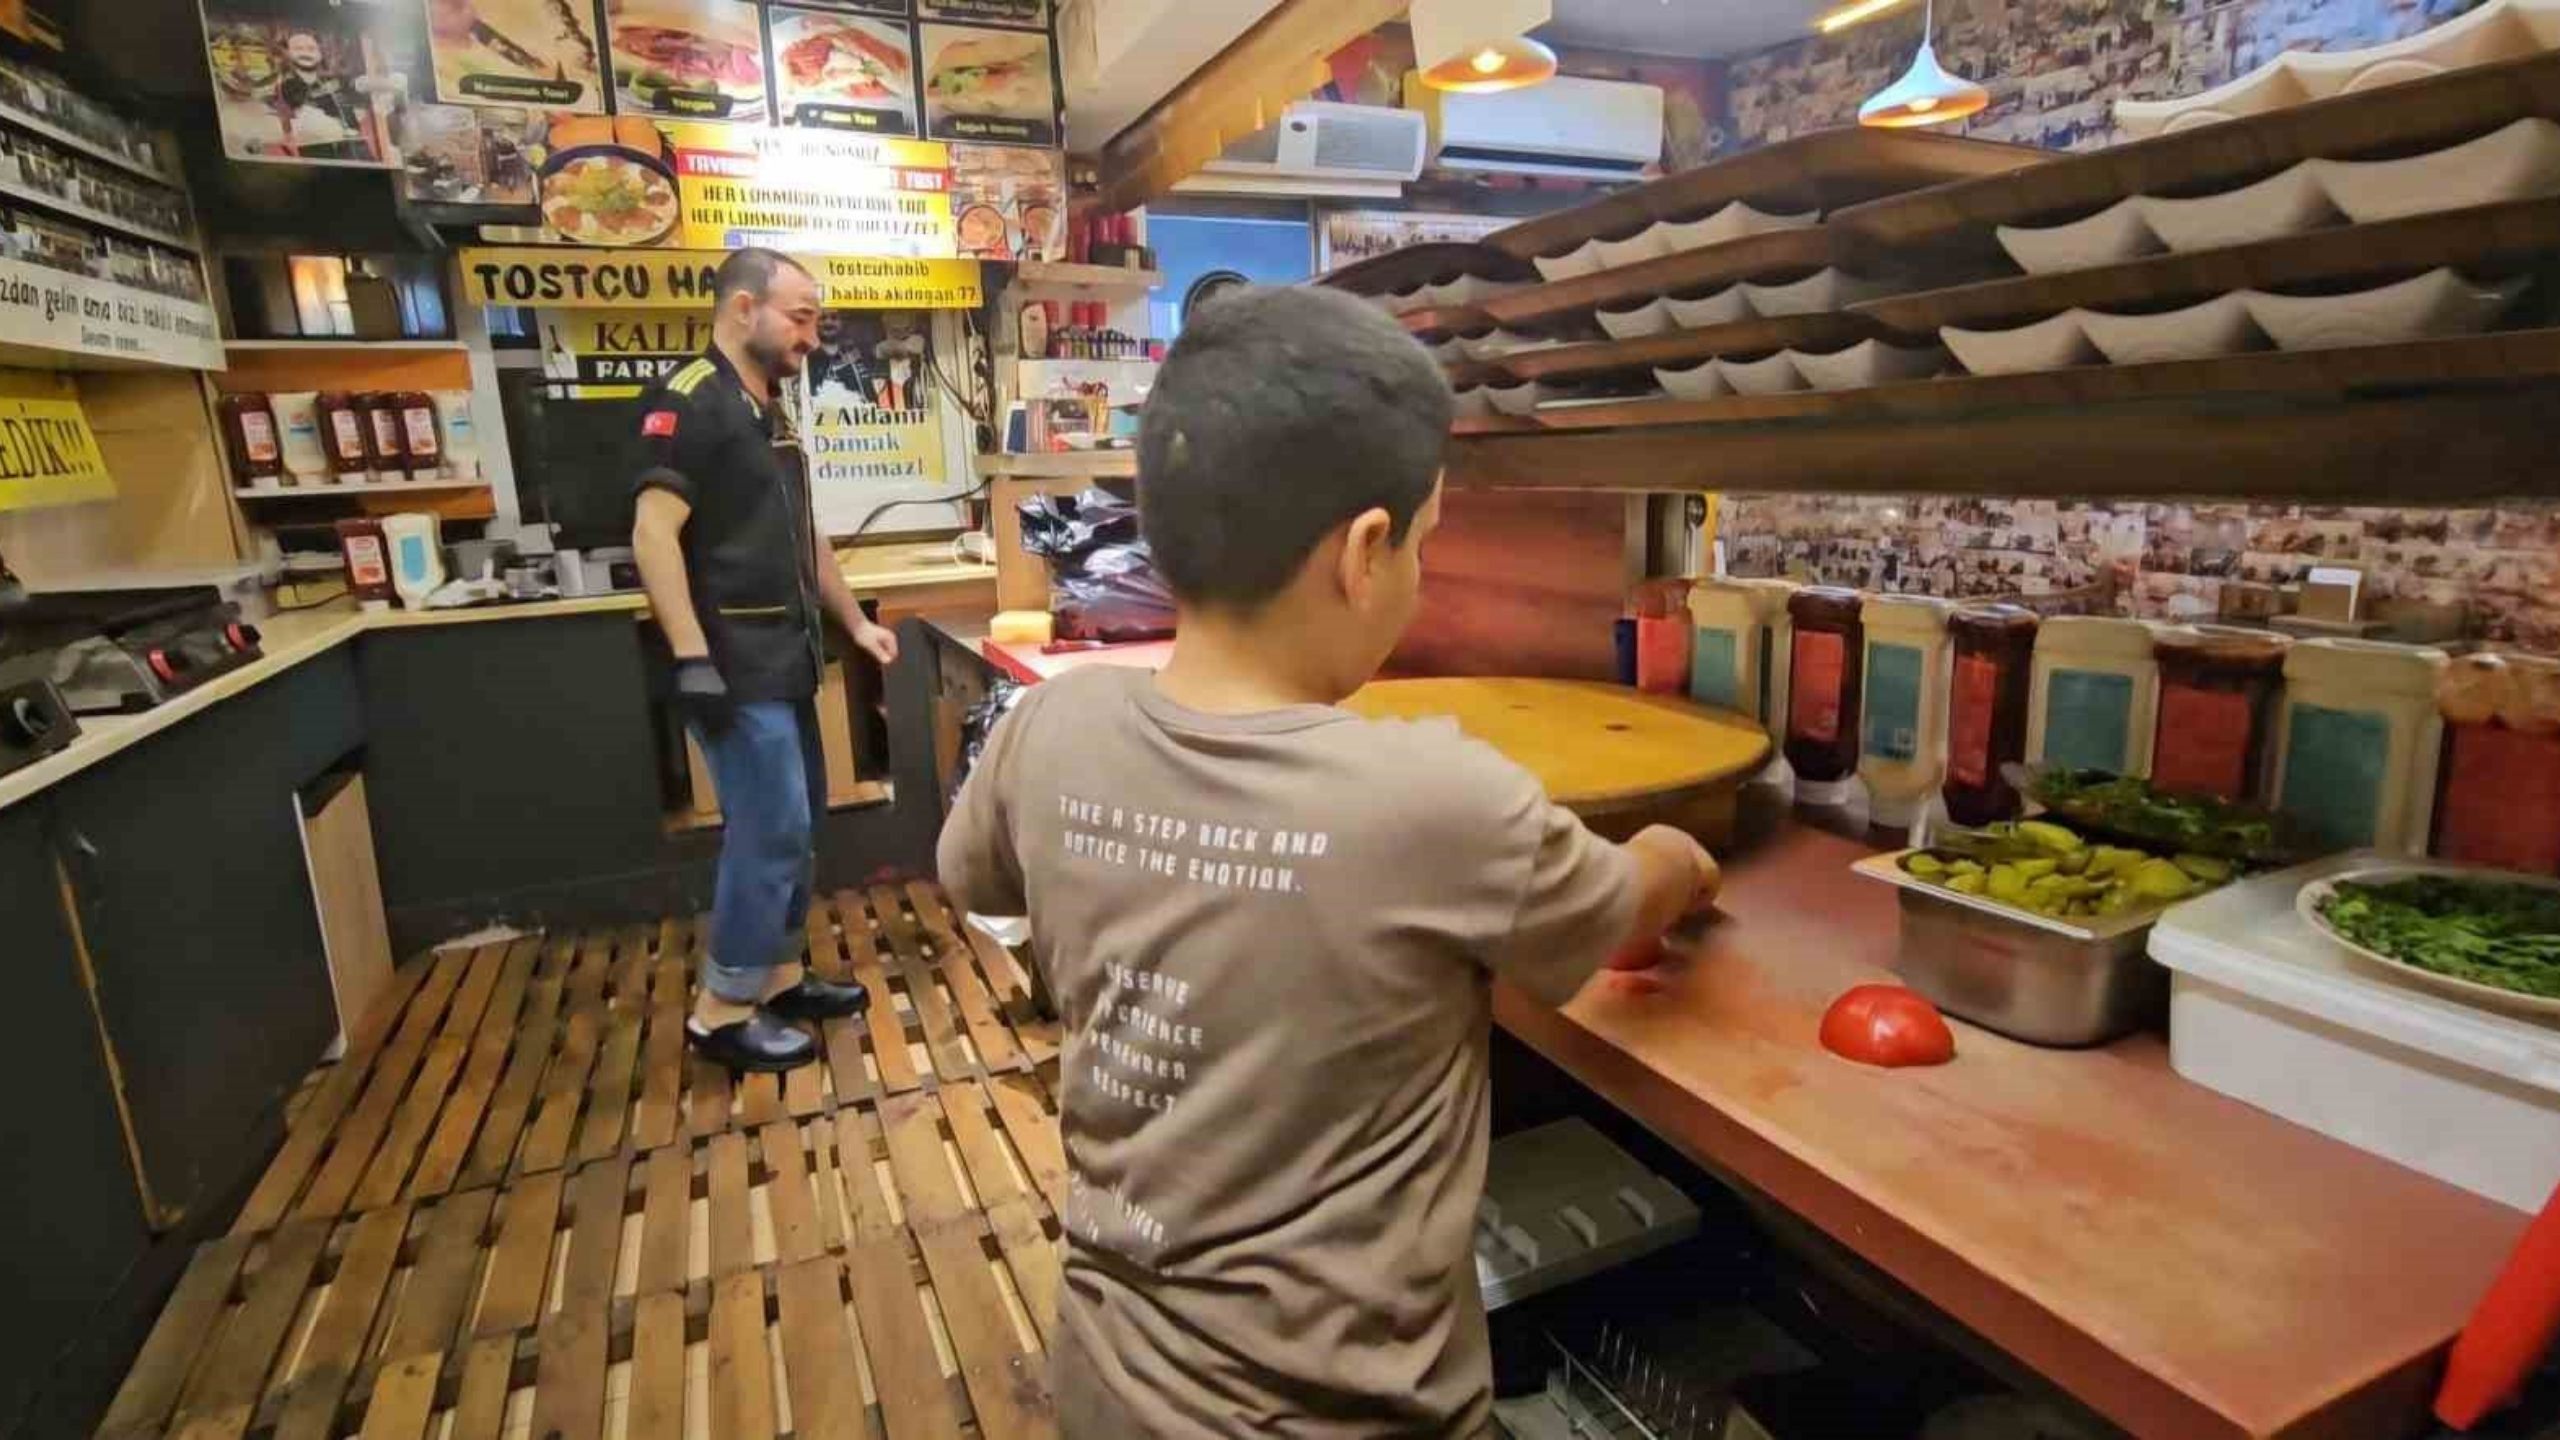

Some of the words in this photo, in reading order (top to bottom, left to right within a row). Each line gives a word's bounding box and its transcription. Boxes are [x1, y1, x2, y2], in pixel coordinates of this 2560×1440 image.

[667, 265, 716, 299] HA
[594, 316, 713, 352] KALİ
[1059, 795, 1102, 826] TAKE
[1112, 808, 1124, 829] A
[1134, 813, 1187, 842] STEP
[1199, 823, 1259, 852] BACK
[1271, 831, 1329, 857] AND
[1063, 830, 1128, 866] NOTICE
[1138, 848, 1178, 876] THE
